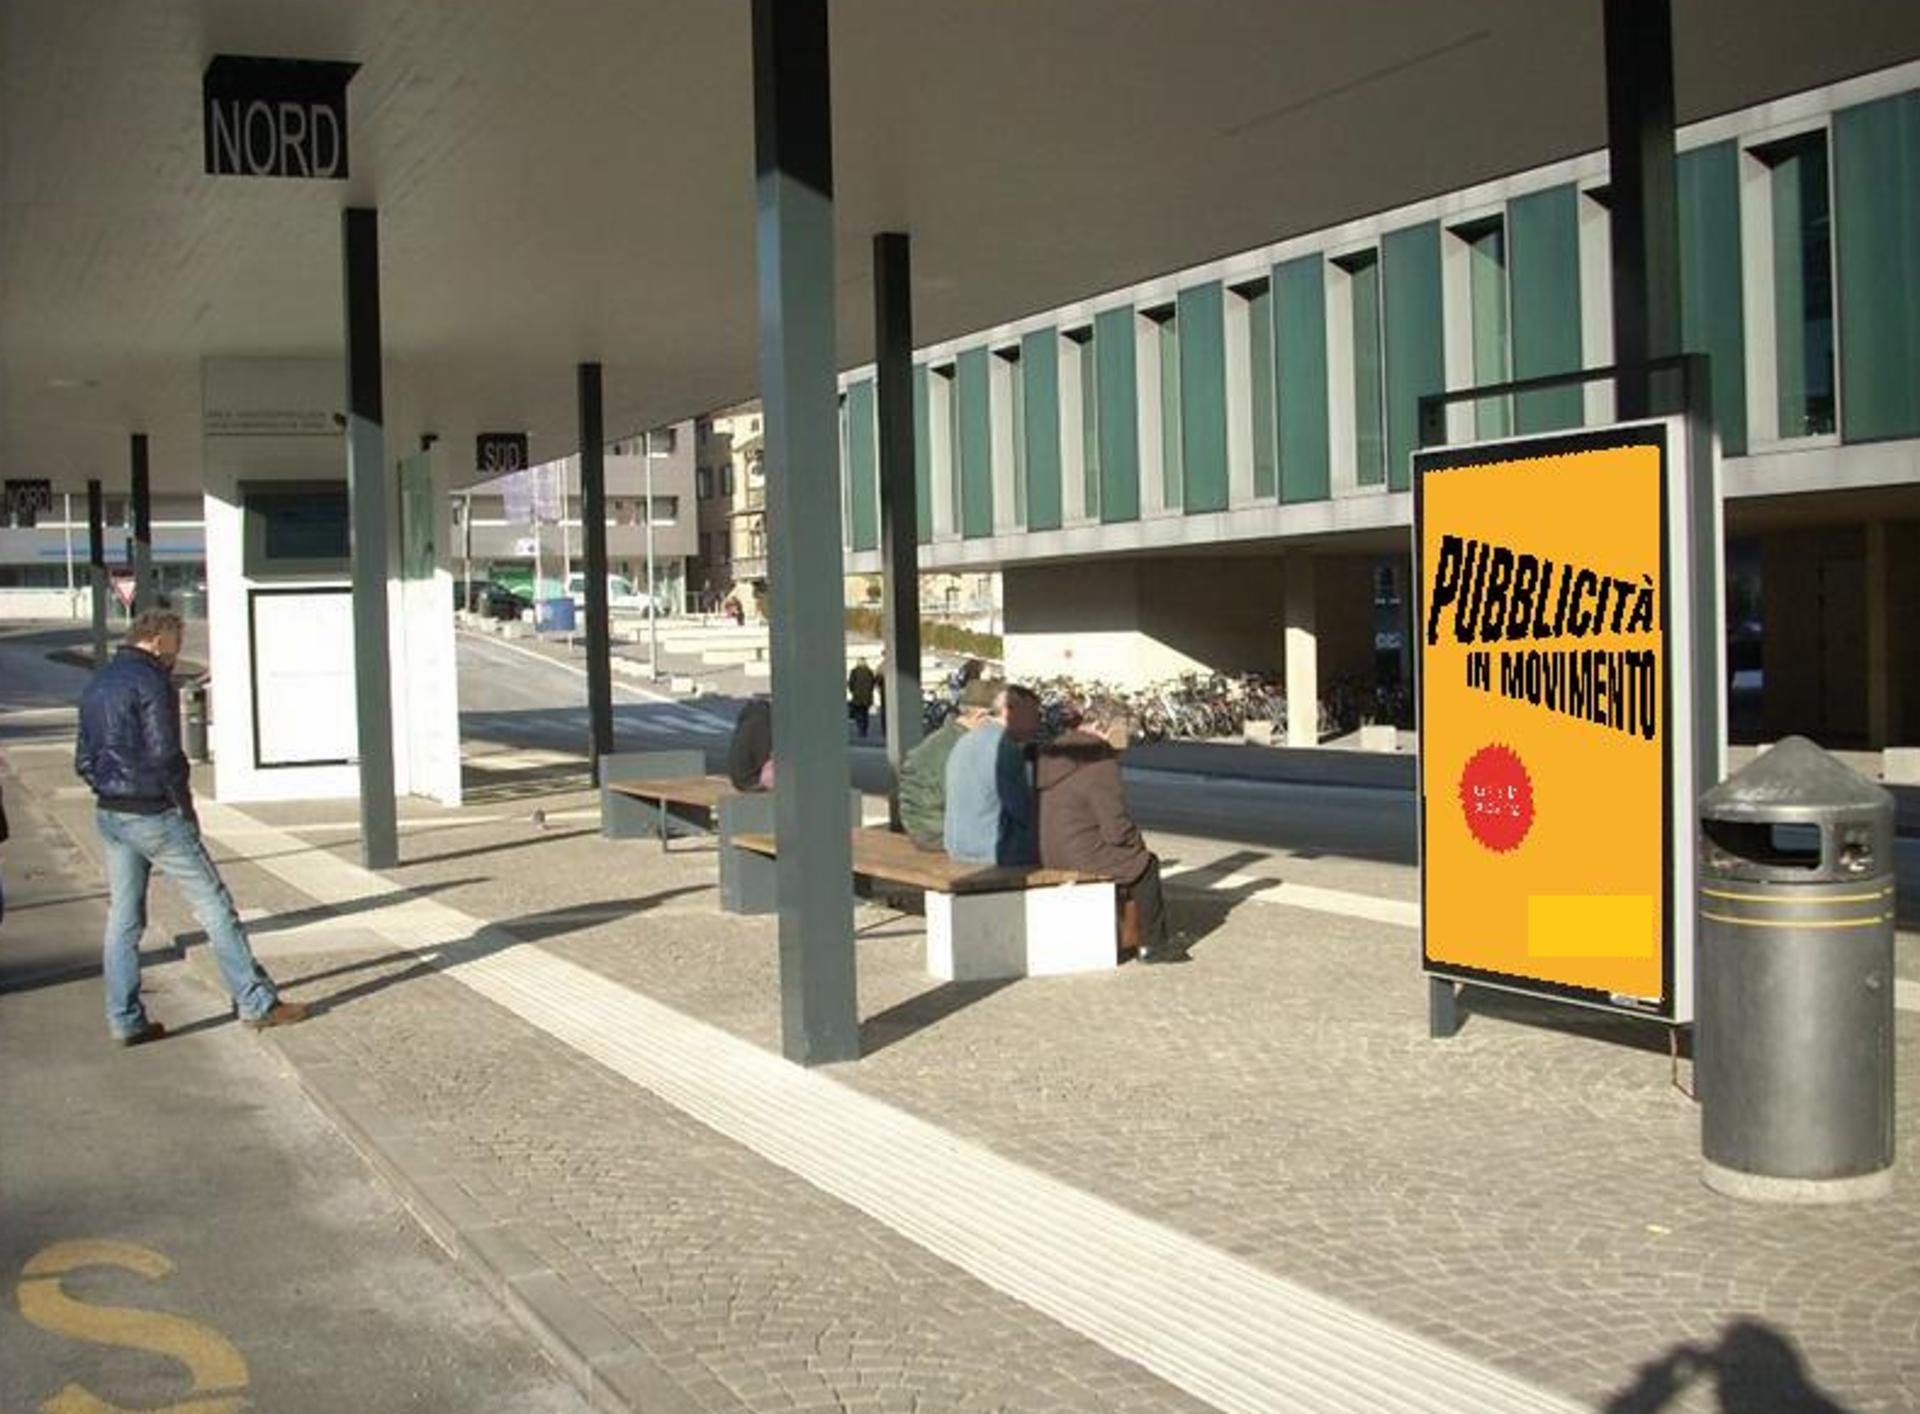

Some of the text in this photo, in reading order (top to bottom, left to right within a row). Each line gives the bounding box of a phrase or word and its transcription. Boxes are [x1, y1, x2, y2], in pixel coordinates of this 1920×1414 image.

[210, 97, 340, 178] NORD
[484, 440, 521, 473] SUD
[1427, 534, 1655, 645] PUBBLICITÀ
[1466, 649, 1656, 740] IN MOVIMENTO
